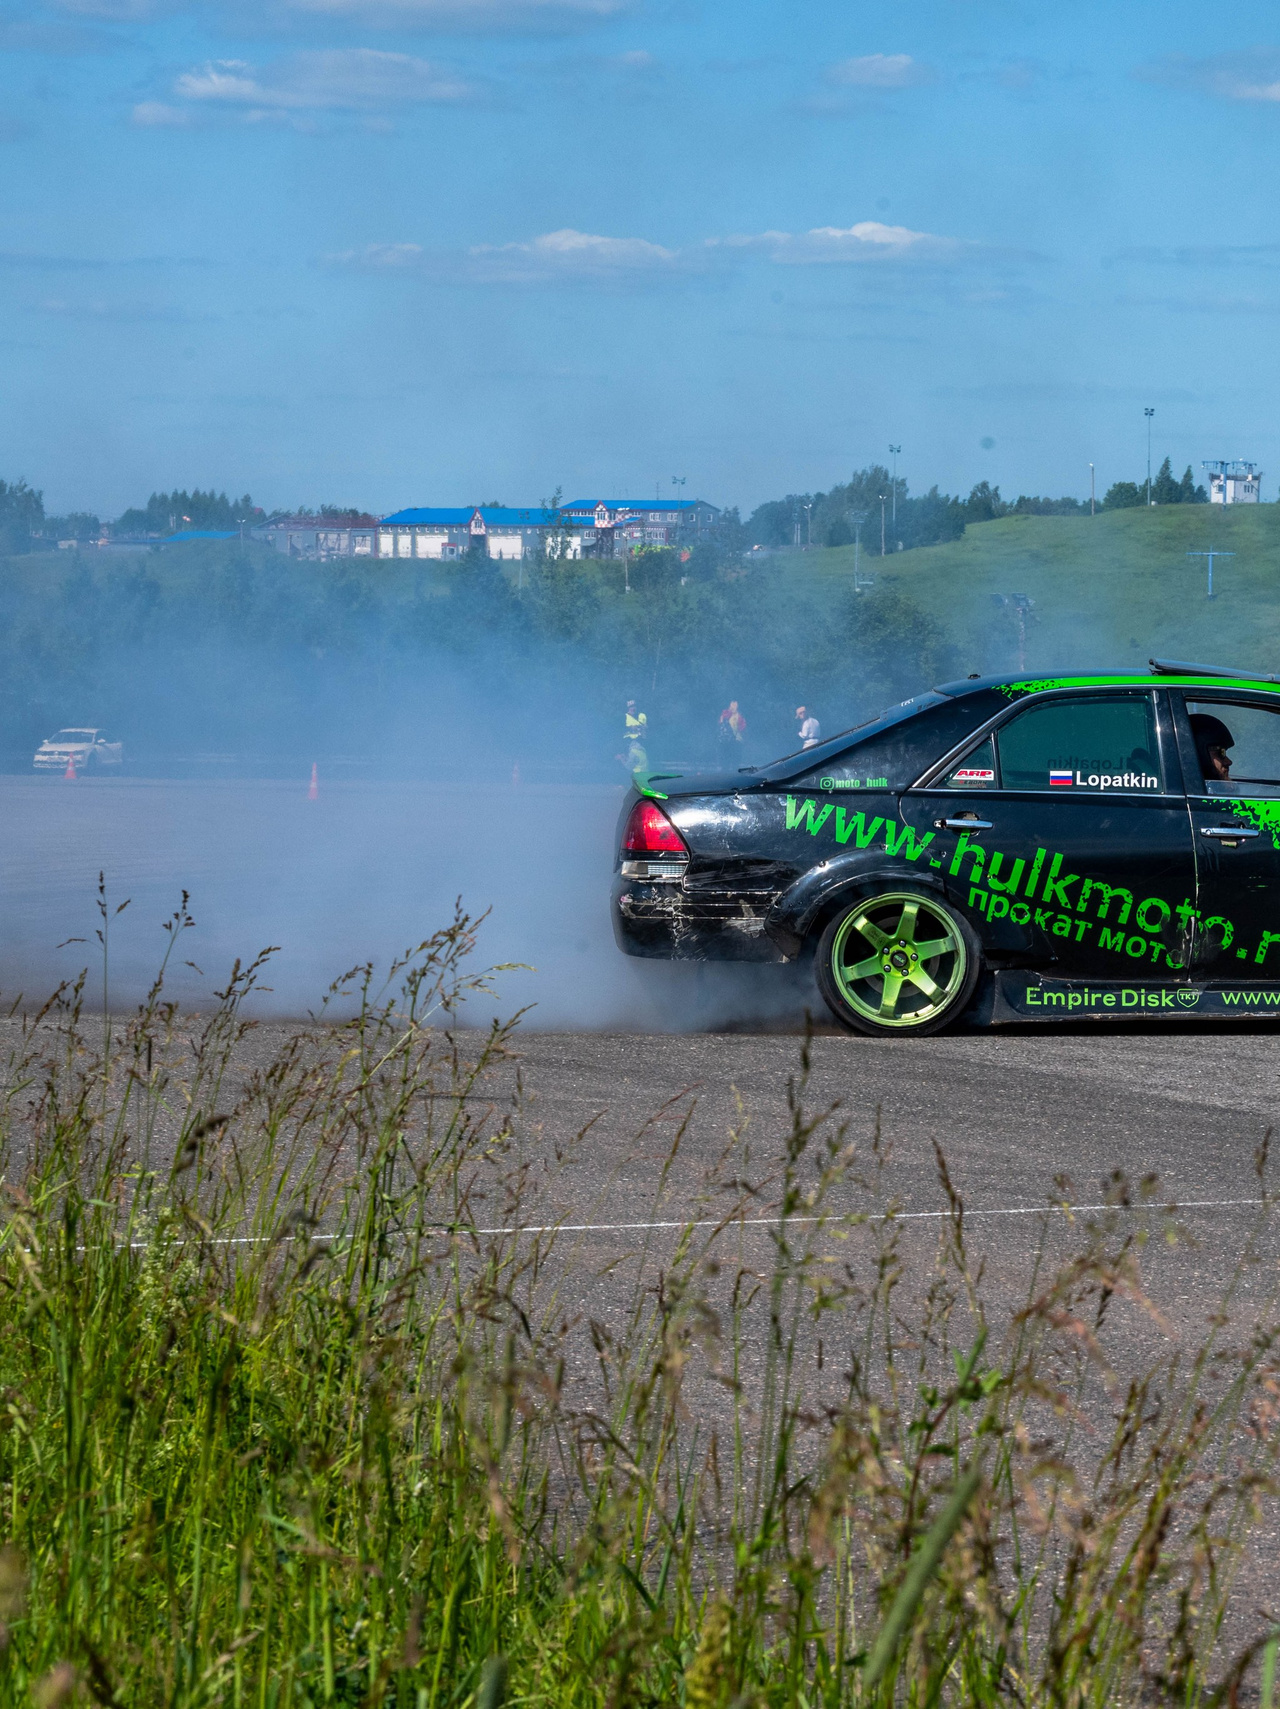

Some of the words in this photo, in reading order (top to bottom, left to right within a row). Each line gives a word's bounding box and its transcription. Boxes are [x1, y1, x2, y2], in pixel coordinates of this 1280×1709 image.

[1076, 771, 1158, 789] Lopatkin
[968, 887, 1093, 943] прокат
[1026, 986, 1116, 1010] Empire
[1121, 988, 1175, 1007] Disk
